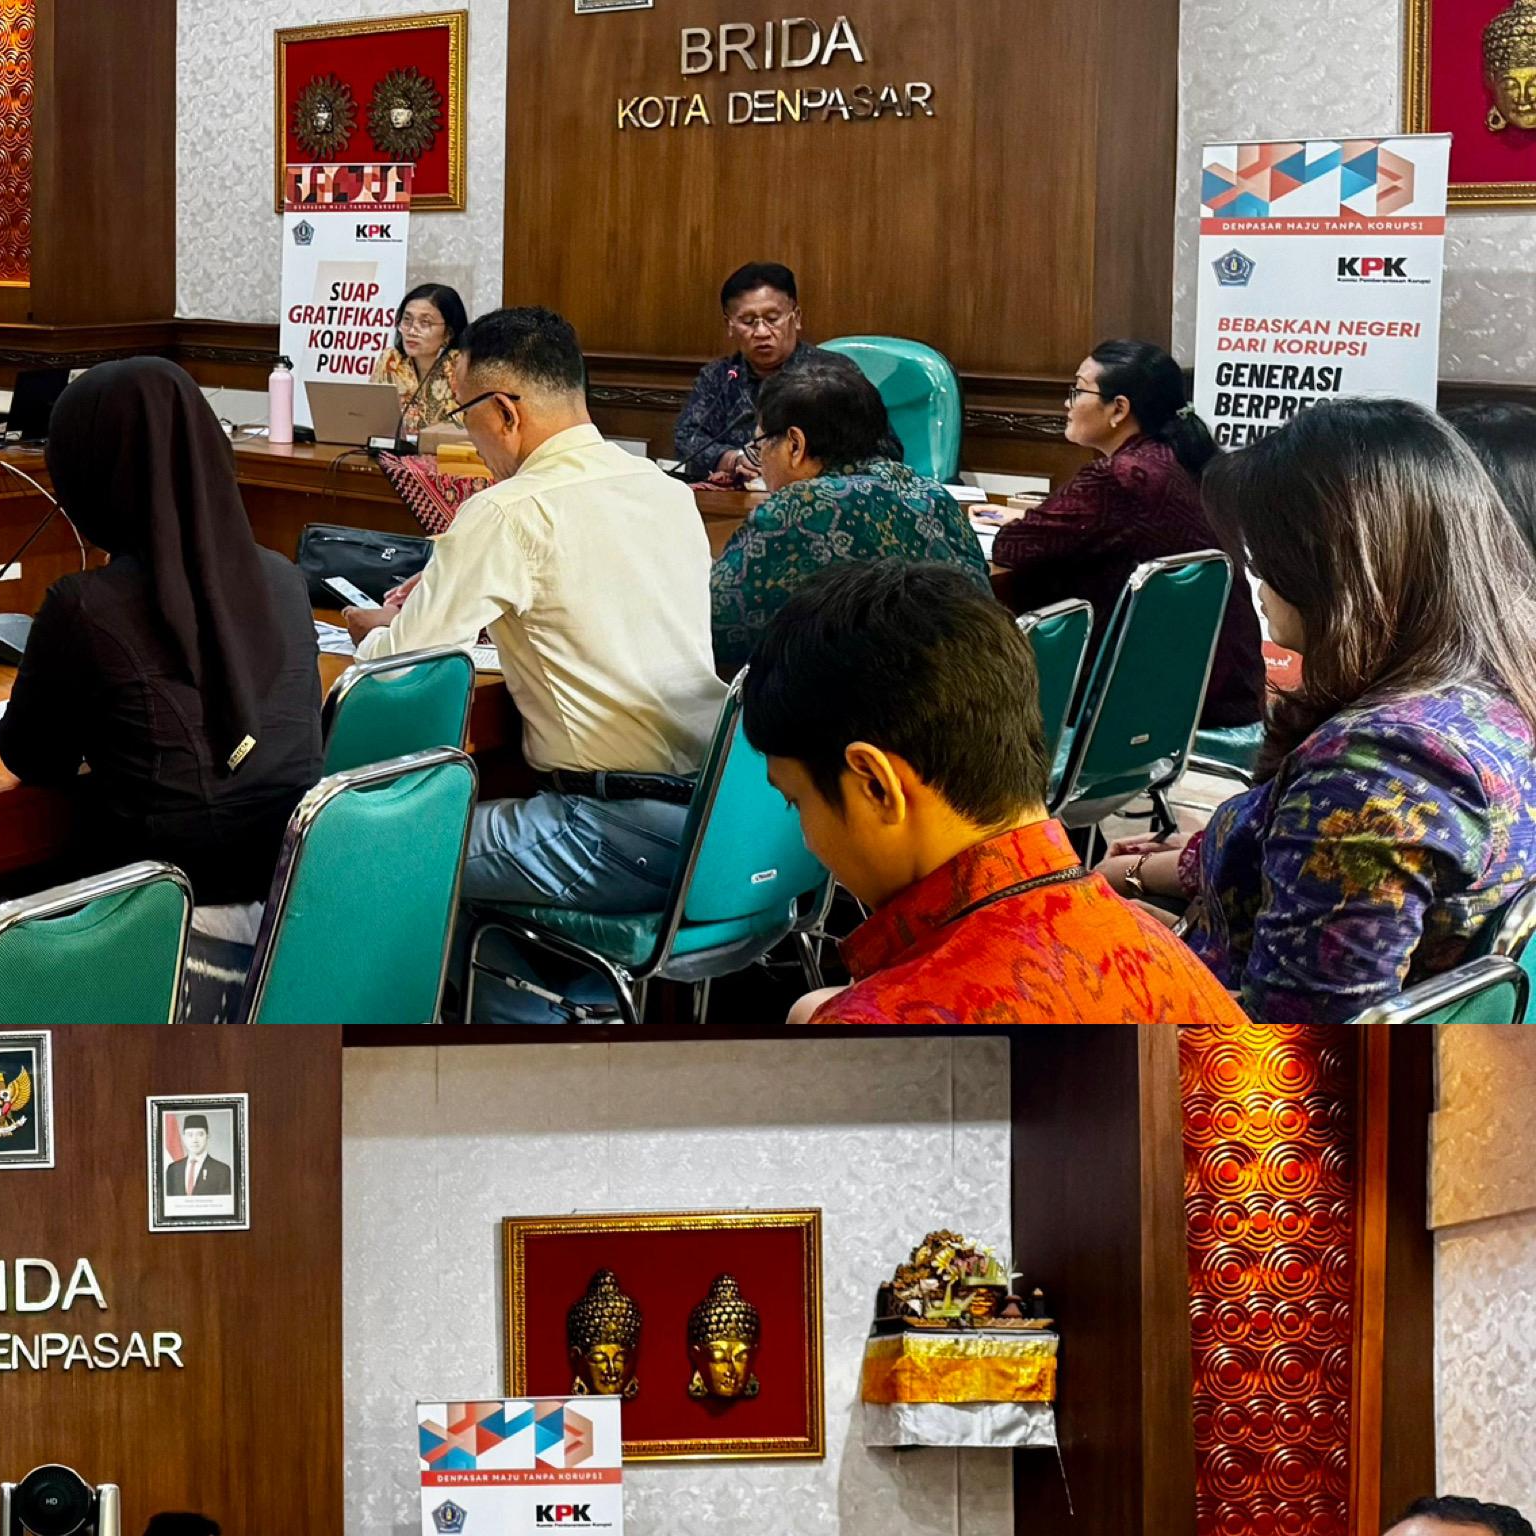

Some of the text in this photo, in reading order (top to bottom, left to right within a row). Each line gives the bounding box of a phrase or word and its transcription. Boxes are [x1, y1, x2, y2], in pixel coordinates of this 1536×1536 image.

[680, 15, 864, 76] BRIDA
[617, 81, 935, 129] KOTA DENPASAR
[356, 224, 391, 238] KPK
[1222, 221, 1424, 231] DENPASAR MAJU TANPA KORUPSI
[1337, 257, 1408, 277] KPK
[330, 282, 379, 302] SUAP
[1217, 317, 1421, 338] BEBASKAN NEGERI
[308, 330, 389, 351] KORUPSI
[1216, 337, 1368, 356] DARI KORUPSI
[1215, 362, 1343, 392] GENERASI
[437, 1475, 488, 1483] DENPASAR
[492, 1474, 519, 1482] MAJU
[558, 1473, 603, 1481] KORUPSI
[536, 1504, 591, 1522] KPK
